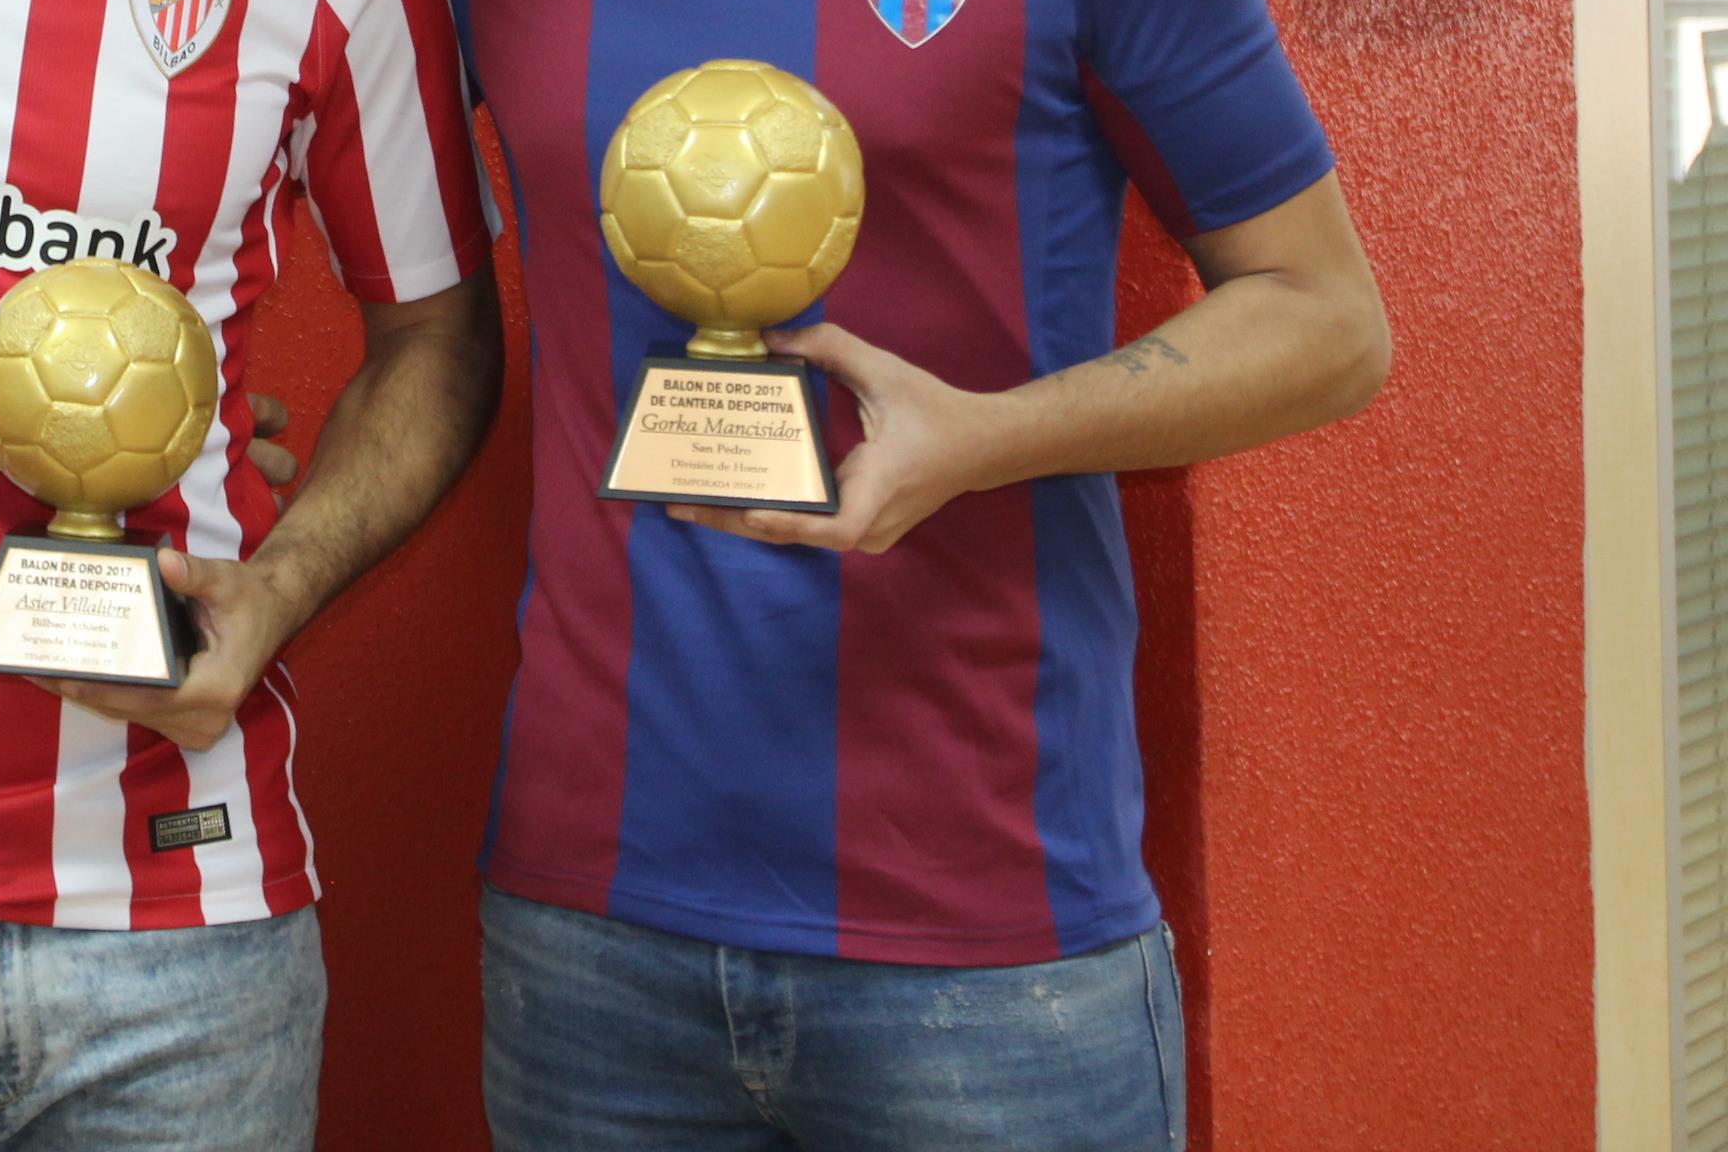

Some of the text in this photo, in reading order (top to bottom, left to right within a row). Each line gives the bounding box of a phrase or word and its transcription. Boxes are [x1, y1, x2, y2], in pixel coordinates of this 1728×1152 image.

[152, 34, 196, 69] BILBAO
[663, 379, 783, 397] BALON DE ORO 2017
[650, 395, 794, 414] DE CANTERA DEPORTIVA
[641, 413, 805, 441] Gorka Mancisidor
[691, 442, 752, 456] San Pedro
[20, 558, 132, 577] BALON DE ORO 2017
[8, 573, 143, 594] DE CANTERA DEPORTIVA
[15, 592, 132, 618] Asier Villalibre
